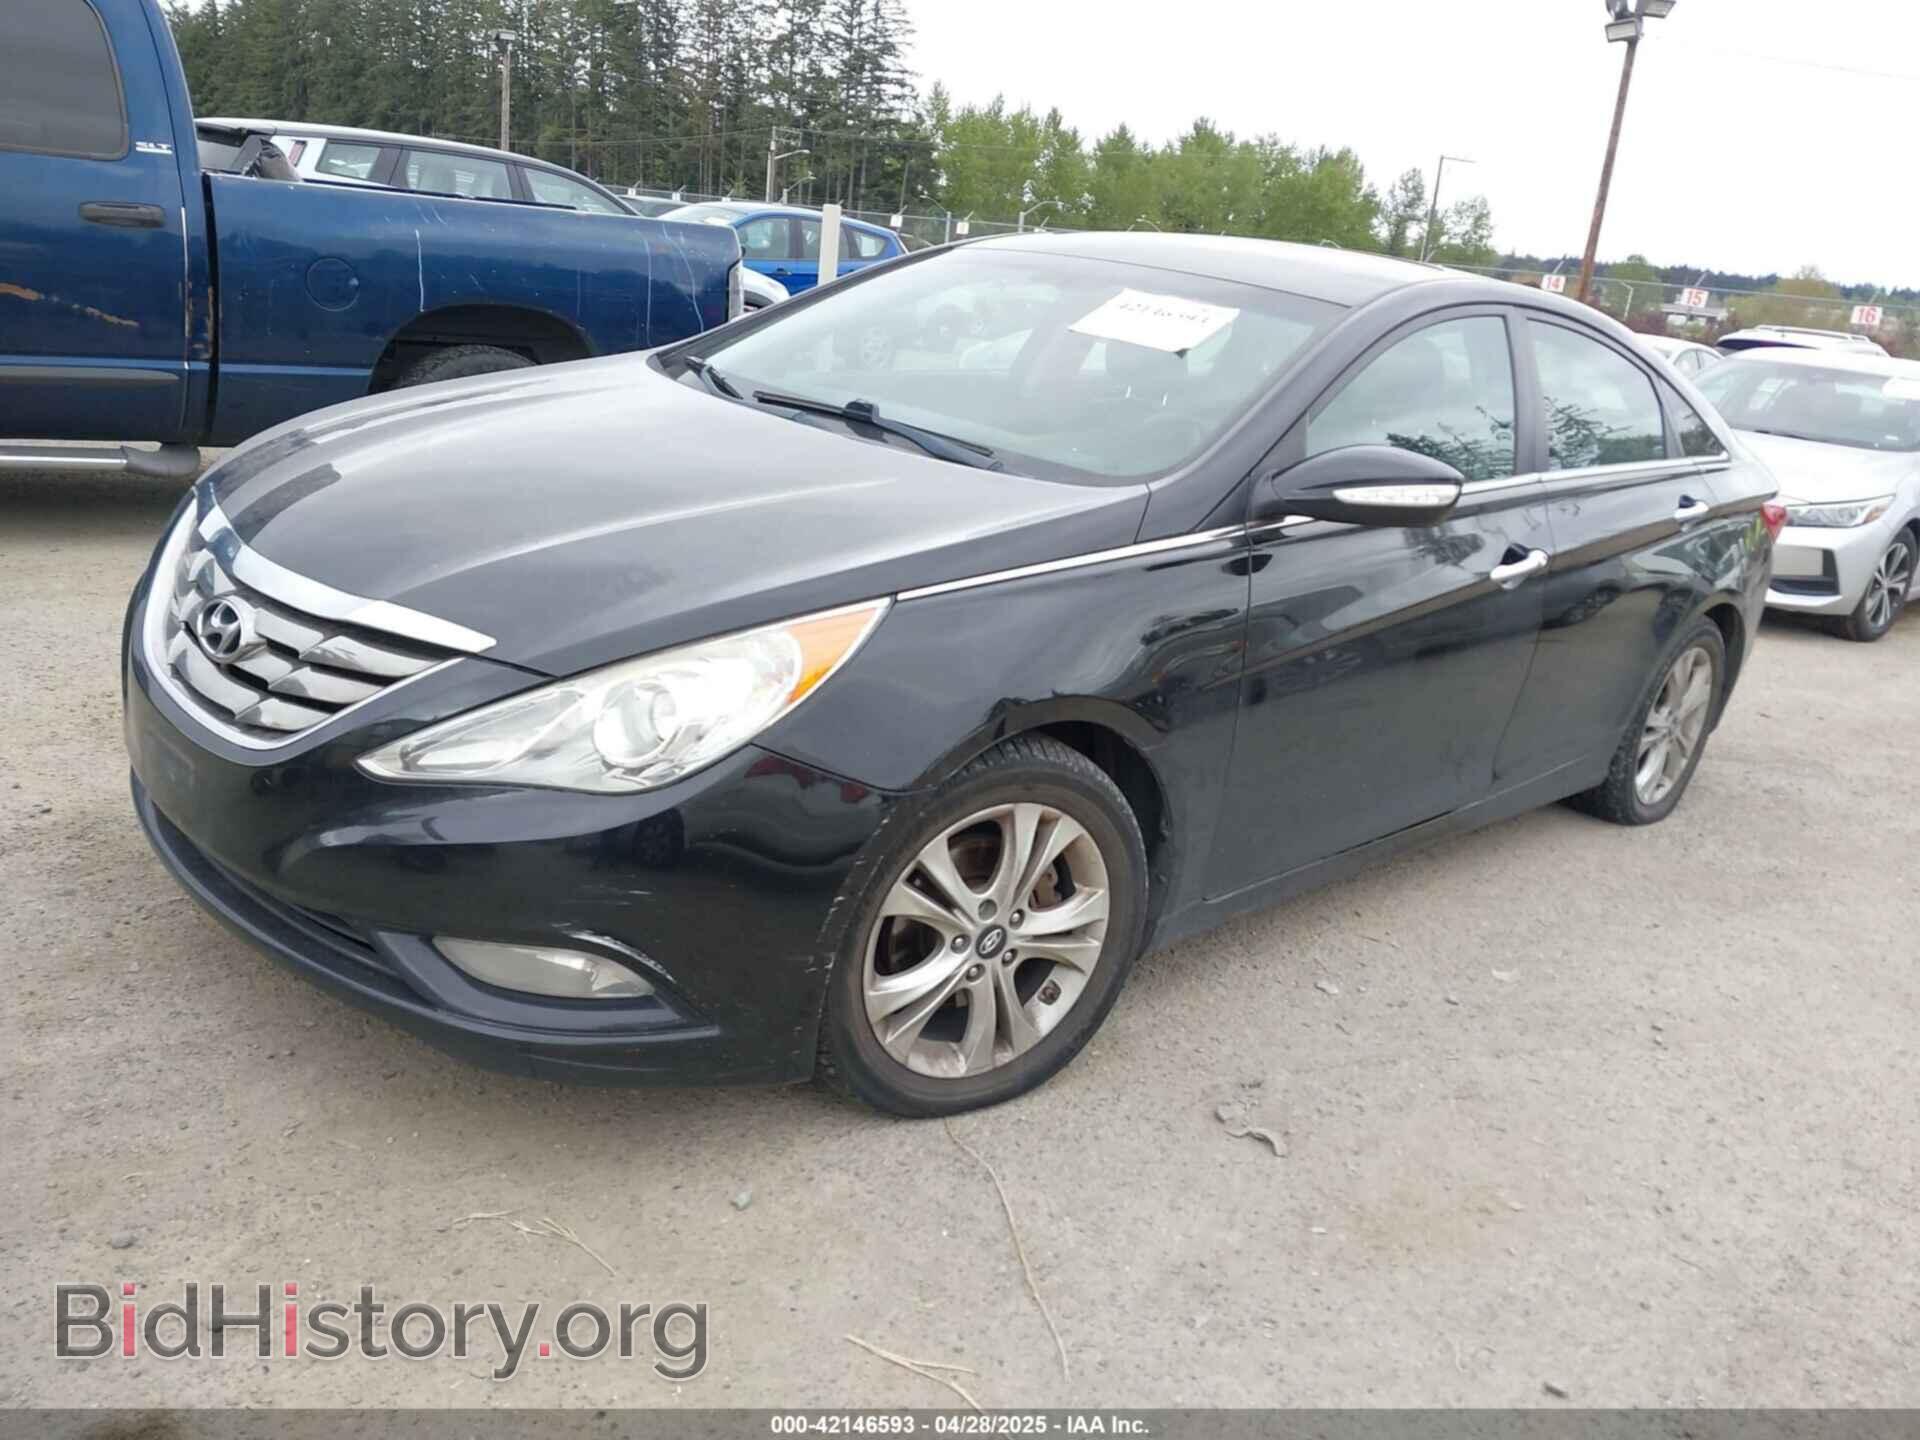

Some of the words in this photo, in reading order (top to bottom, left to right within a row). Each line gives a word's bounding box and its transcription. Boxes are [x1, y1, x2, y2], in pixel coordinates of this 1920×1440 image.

[136, 141, 172, 153] SLT
[1546, 276, 1561, 289] 14
[1686, 290, 1702, 305] 15
[1857, 308, 1877, 323] 16
